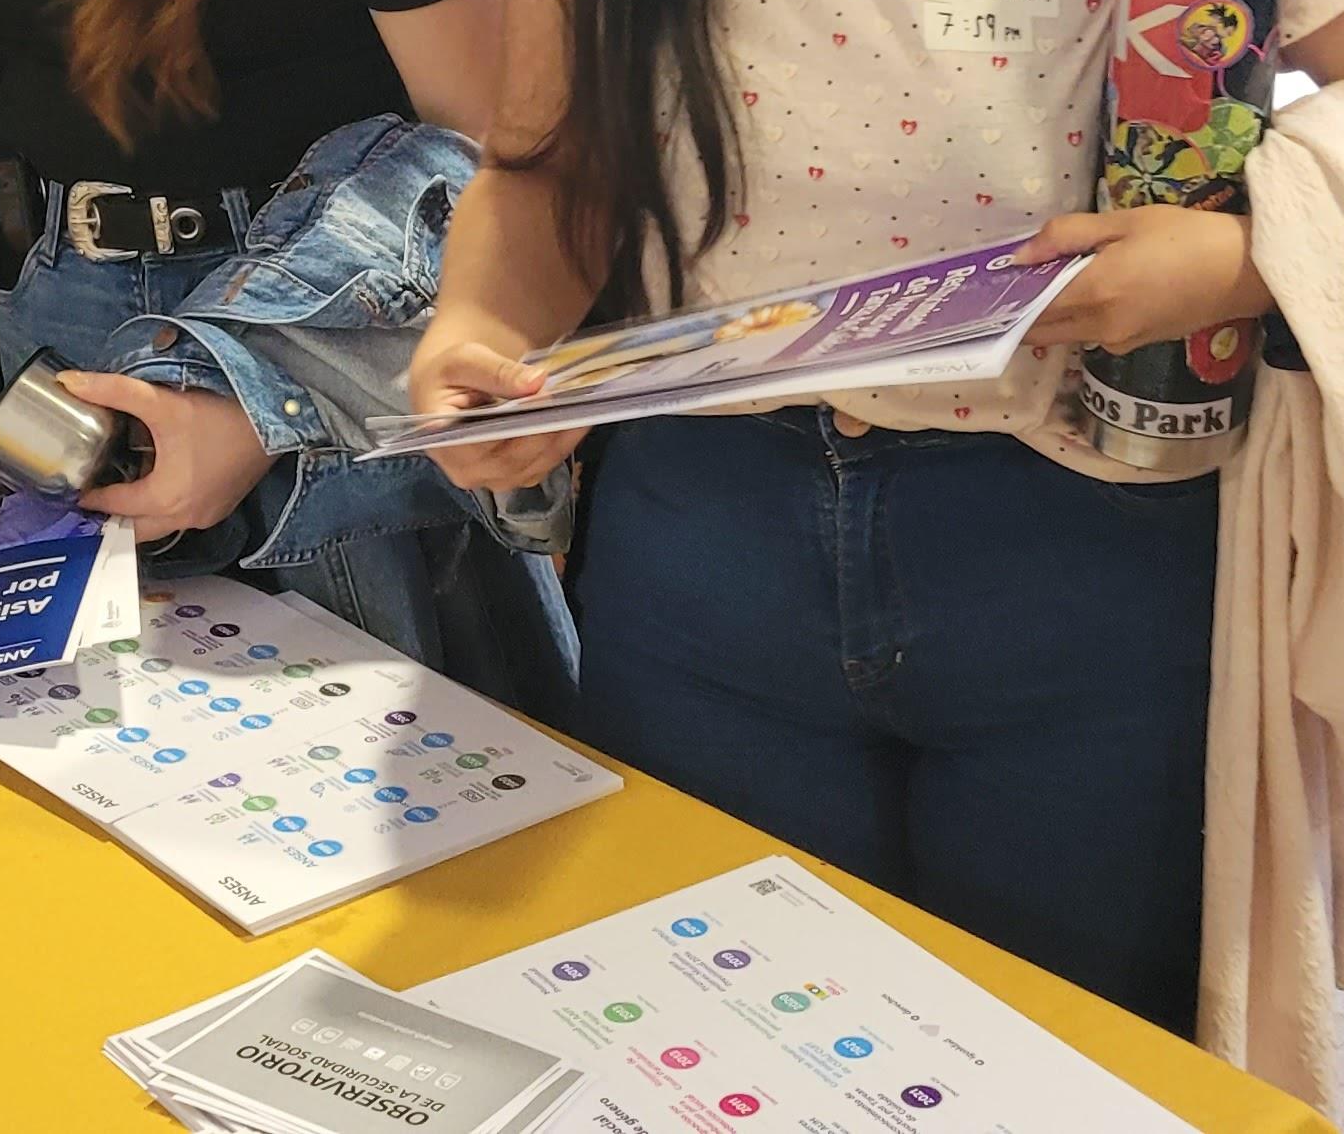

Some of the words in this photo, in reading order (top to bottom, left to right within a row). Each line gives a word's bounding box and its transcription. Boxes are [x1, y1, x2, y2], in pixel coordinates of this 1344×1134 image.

[937, 11, 996, 41] 7:59
[1131, 401, 1226, 436] Park
[3, 570, 61, 597] por
[71, 782, 120, 809] ANSES
[218, 875, 266, 906] ANSES
[258, 1034, 313, 1061] SOCIAL
[235, 1044, 430, 1126] OBSERVATORIO
[310, 1055, 398, 1094] SEGURIDAD
[398, 1088, 422, 1104] LA
[418, 1097, 446, 1113] DE
[907, 1087, 936, 1106] 2021
[599, 1097, 637, 1127] género
